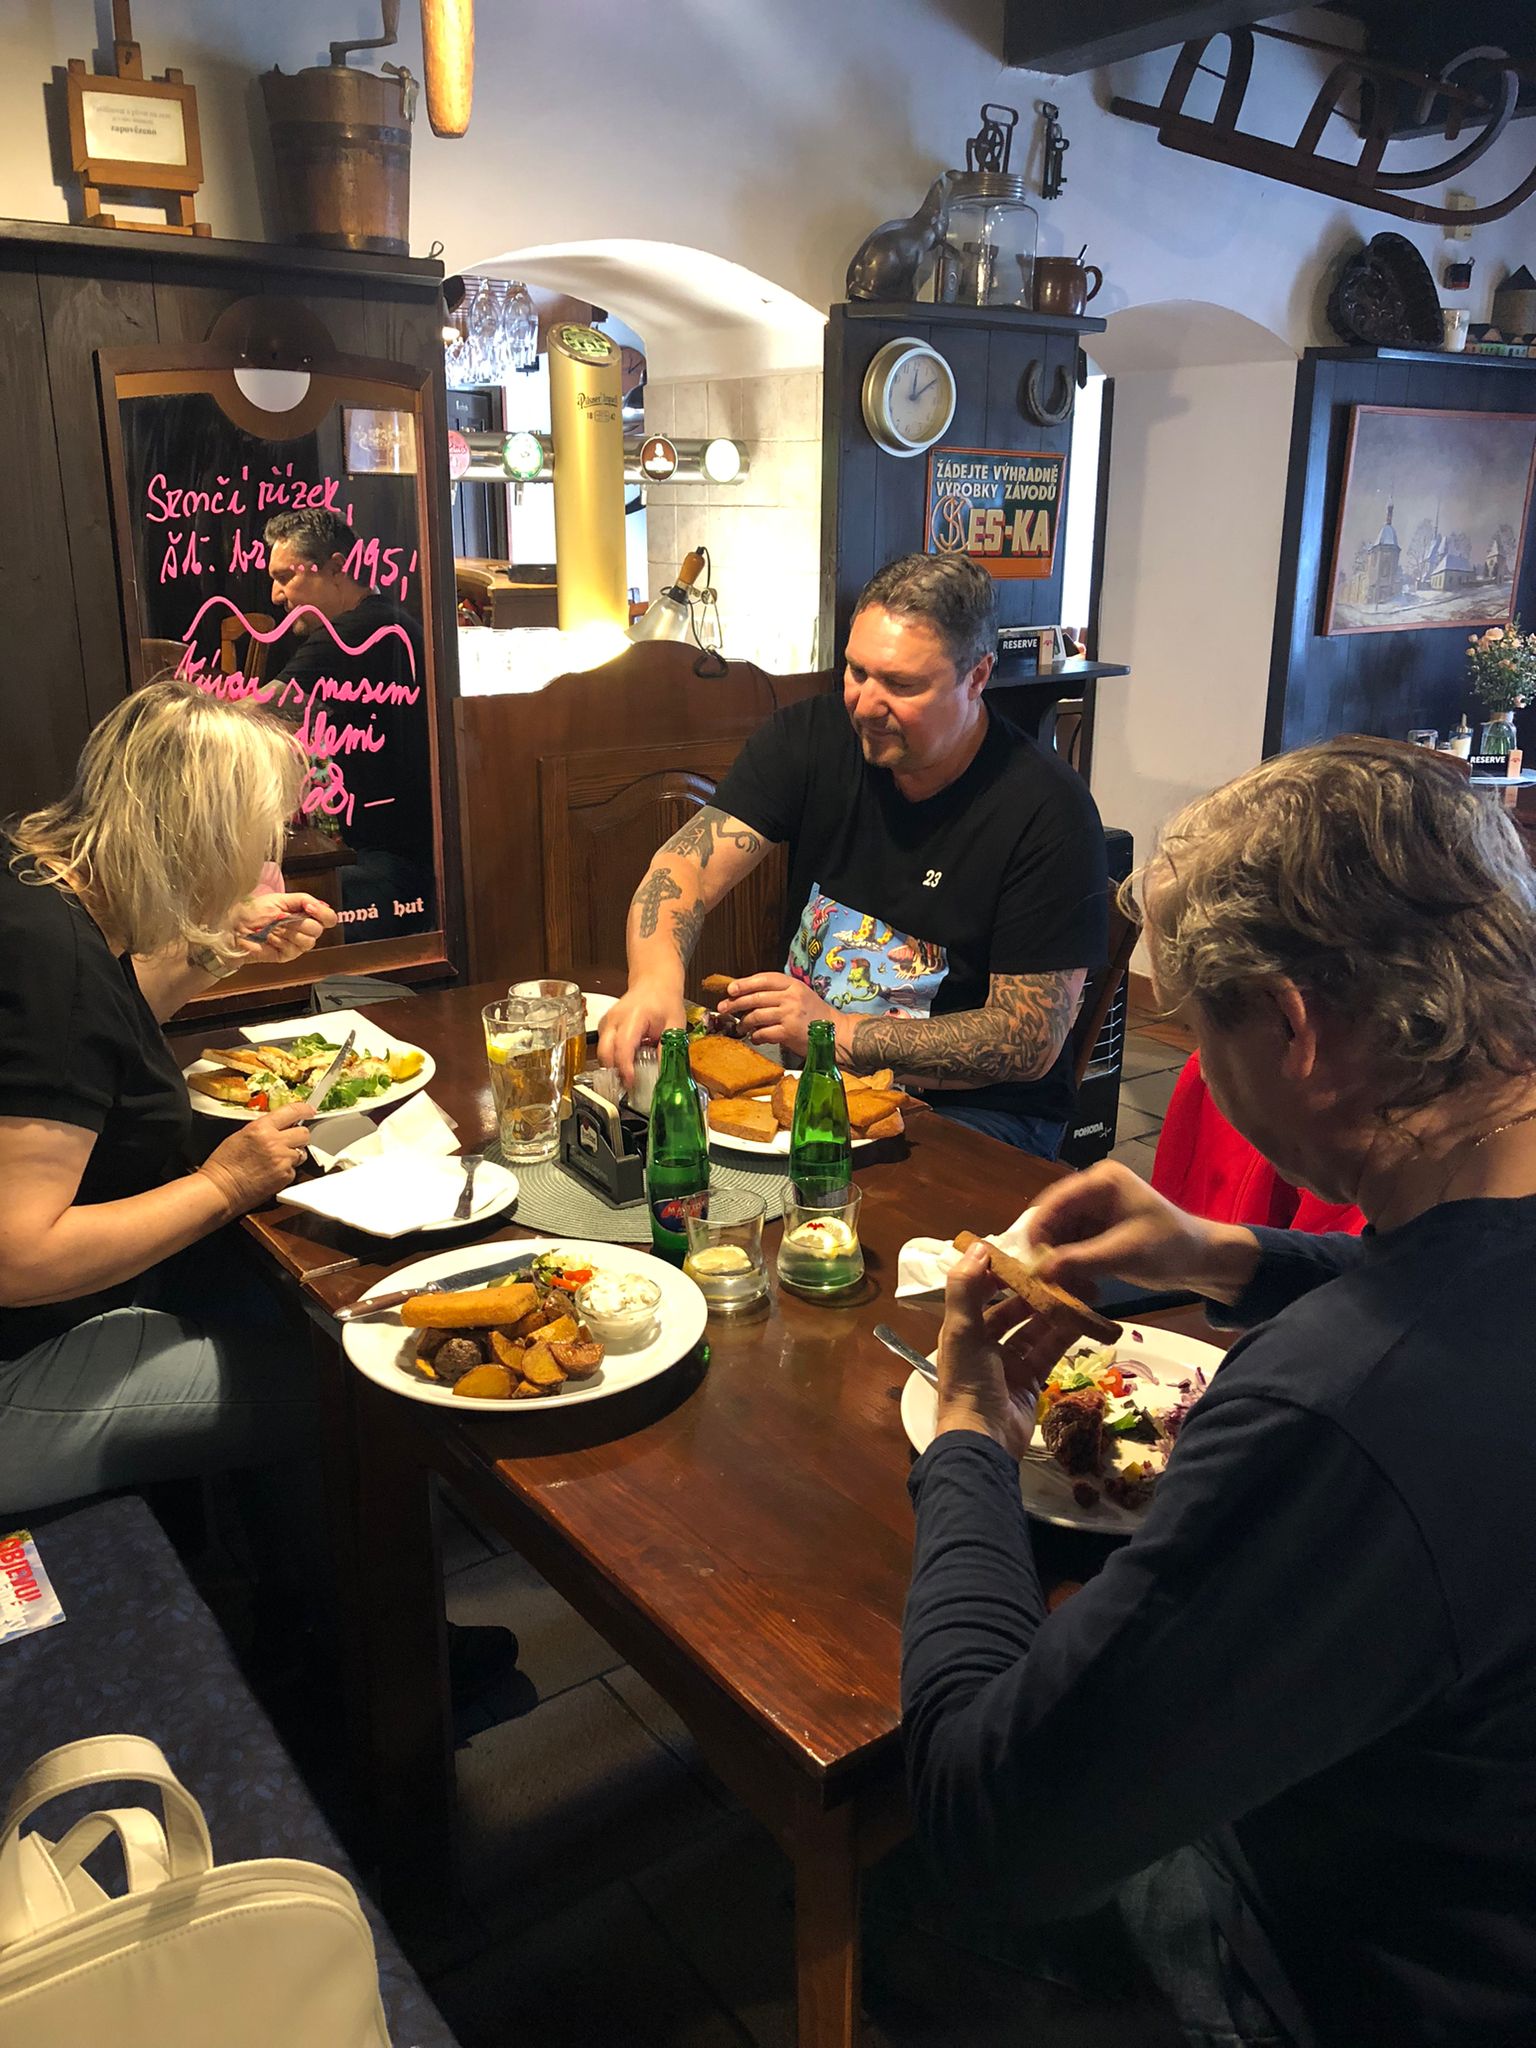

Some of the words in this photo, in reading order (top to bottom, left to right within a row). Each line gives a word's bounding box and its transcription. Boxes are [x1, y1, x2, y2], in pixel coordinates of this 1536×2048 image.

[936, 459, 989, 481] ŽÁDEJTE
[993, 462, 1059, 484] VÝHRADNĚ
[936, 479, 999, 499] VÝROBKY
[1004, 480, 1057, 501] ZÁVODŮ
[967, 508, 1051, 557] ES-KA
[1003, 638, 1038, 650] RESERVE
[1470, 755, 1506, 764] RESERVE
[922, 869, 943, 888] 23
[1073, 1122, 1105, 1139] POHODA
